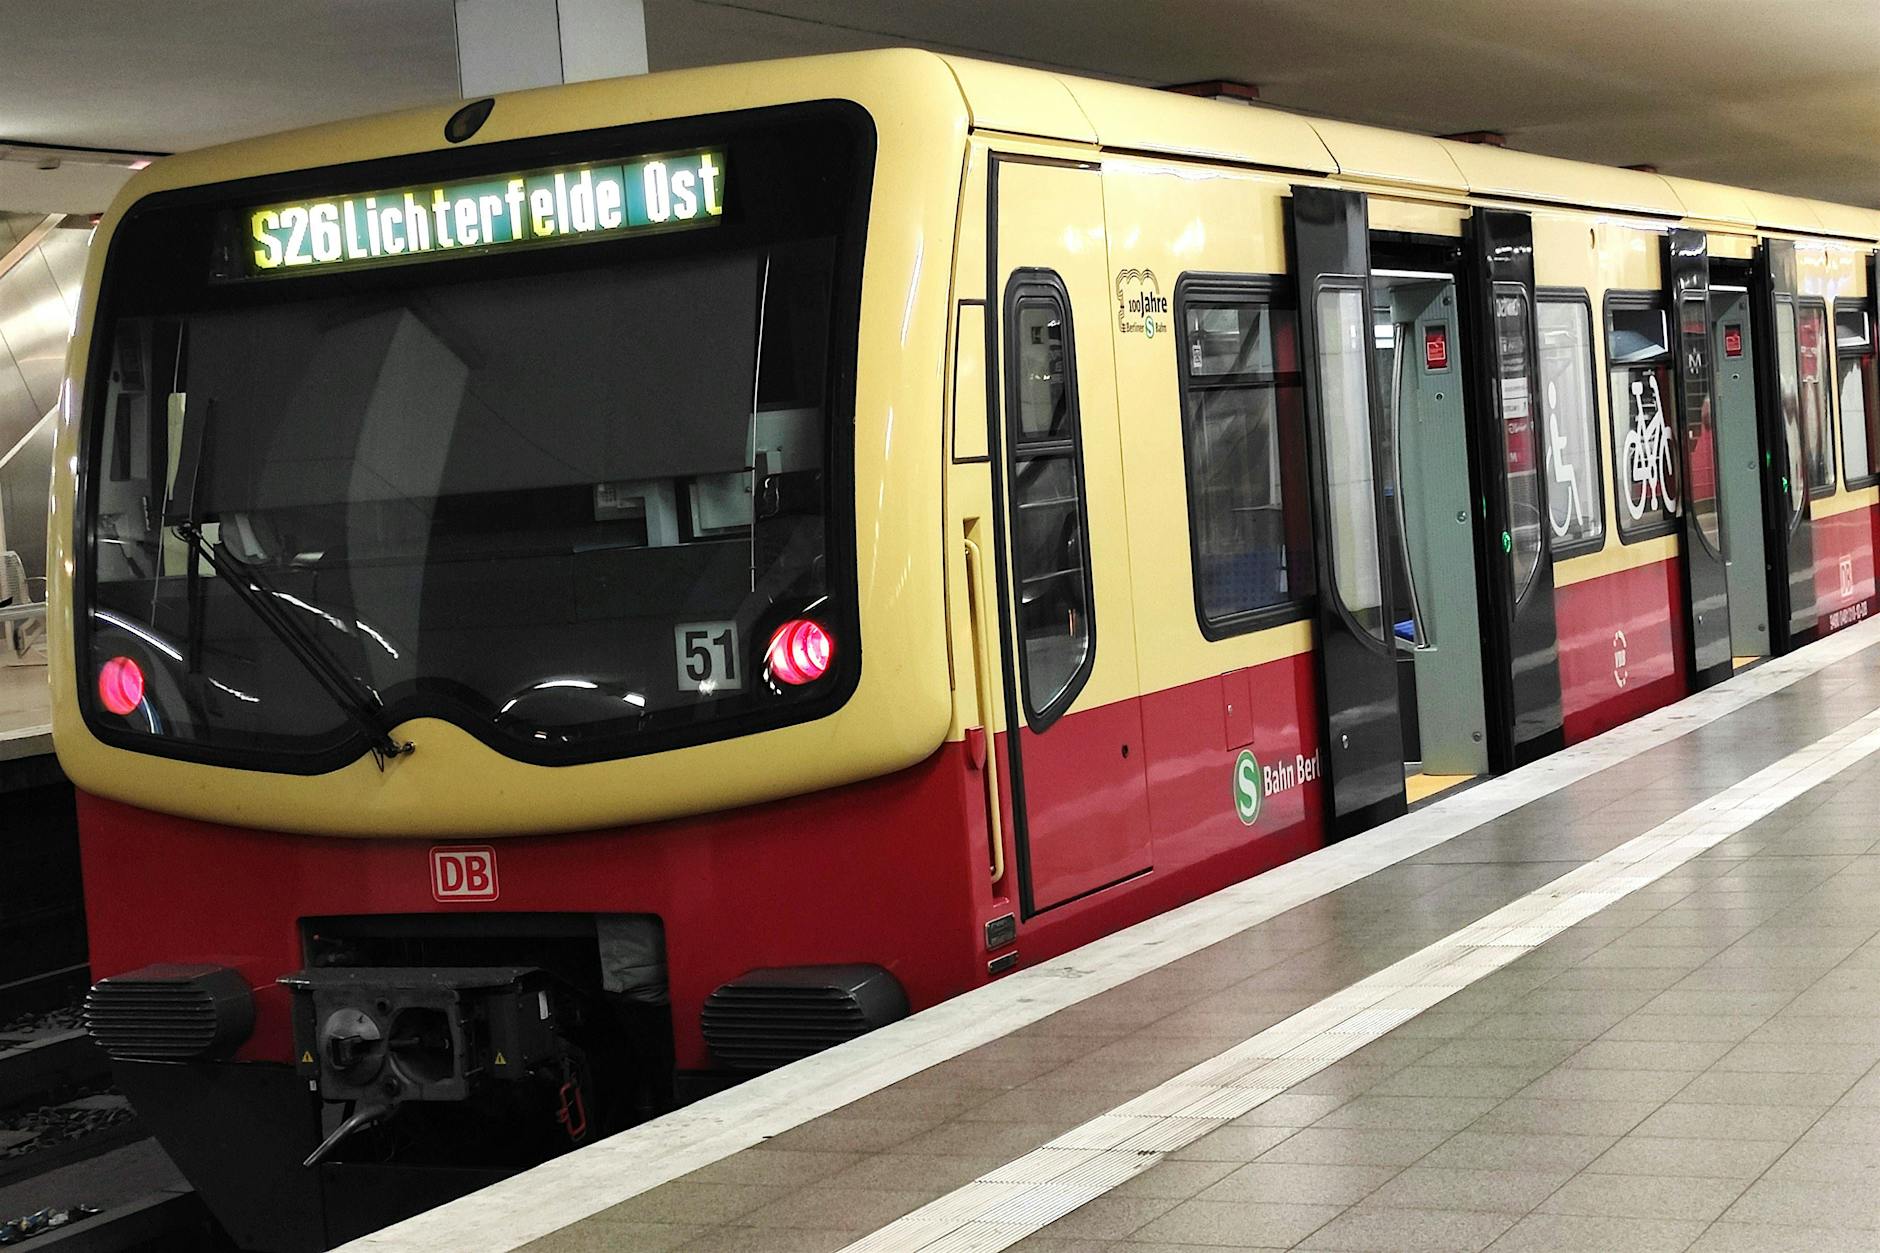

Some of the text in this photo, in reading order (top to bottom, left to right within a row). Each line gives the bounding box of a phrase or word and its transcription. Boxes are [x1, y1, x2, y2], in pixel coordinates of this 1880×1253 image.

[251, 154, 723, 269] S26 Lichterfelde Ost
[685, 629, 736, 682] 51
[1238, 758, 1258, 818] S
[1263, 760, 1295, 798] Bahn
[438, 854, 490, 893] DB
